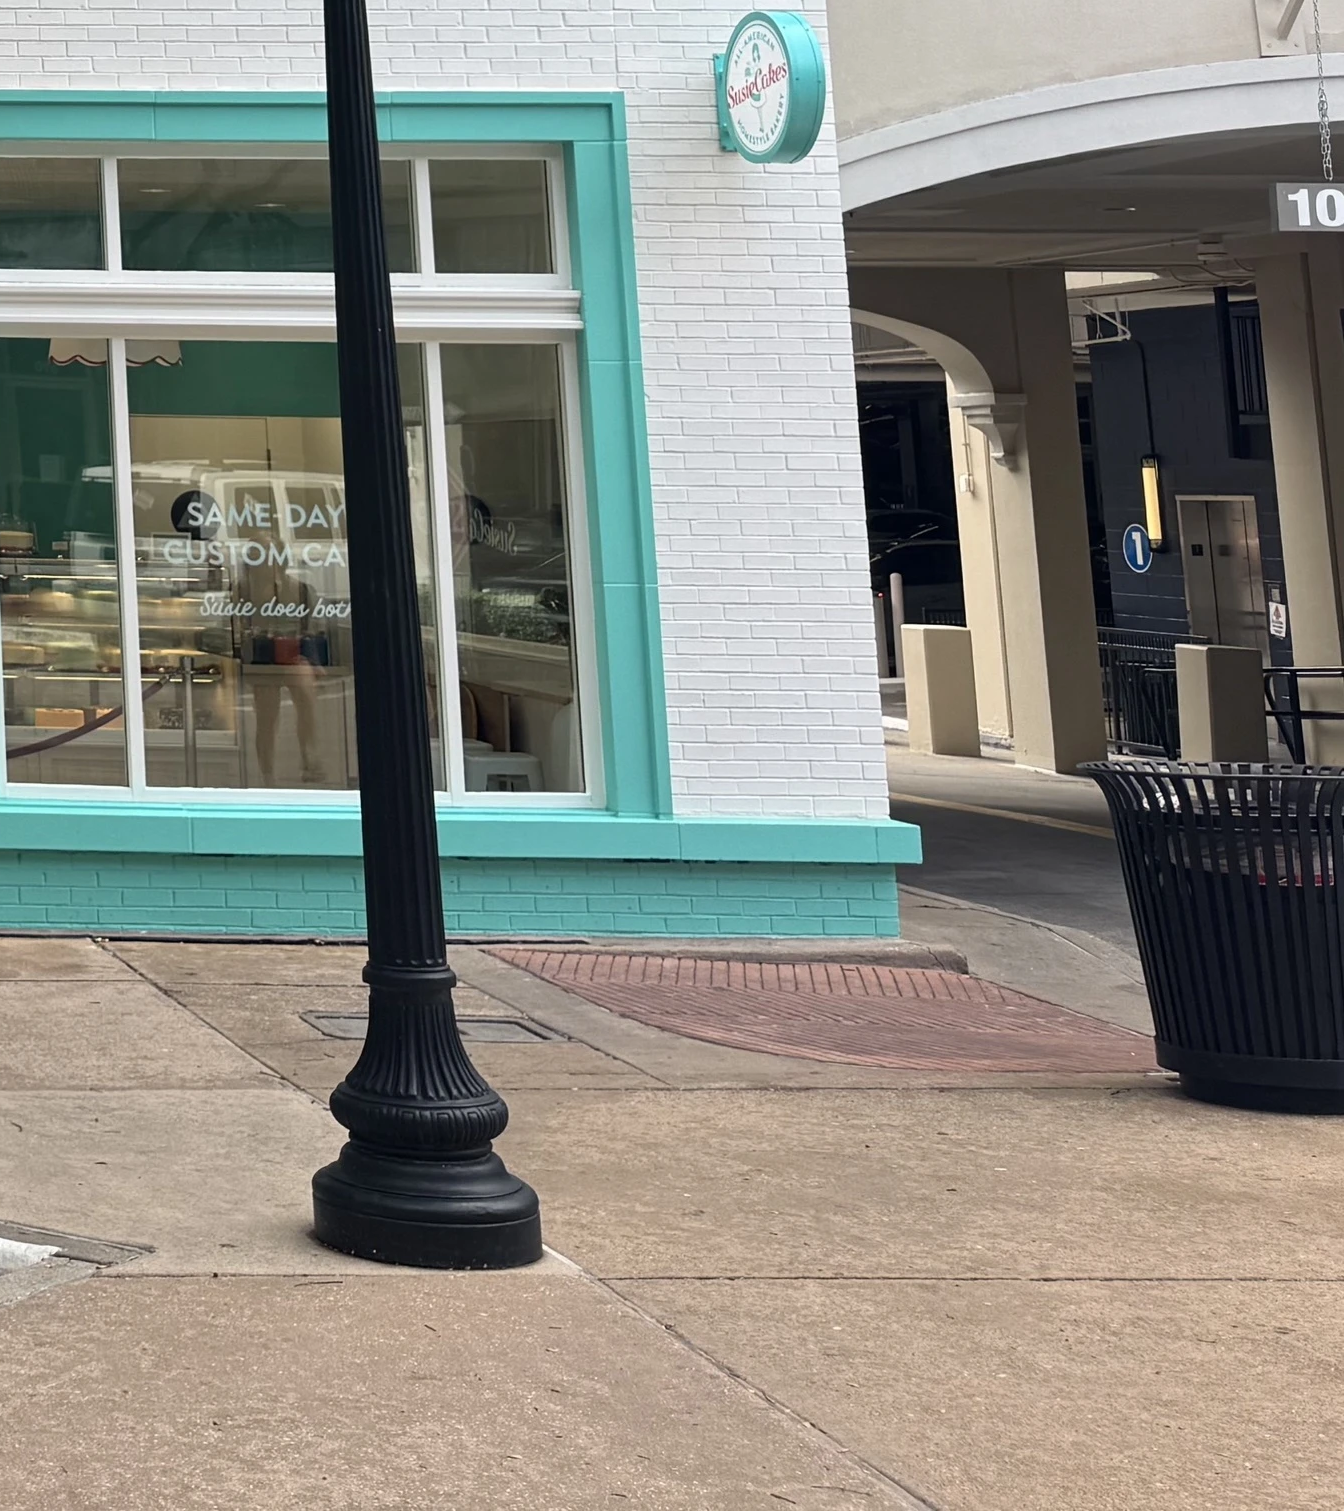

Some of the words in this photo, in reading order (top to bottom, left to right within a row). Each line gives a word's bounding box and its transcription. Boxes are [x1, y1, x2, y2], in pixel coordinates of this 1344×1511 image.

[727, 62, 788, 110] SusieCakes
[187, 502, 345, 529] SAME-DAY
[163, 540, 294, 567] CUSTOM
[1131, 531, 1144, 565] 1
[200, 593, 257, 617] Susie
[260, 596, 309, 618] does
[312, 598, 351, 618] bot
